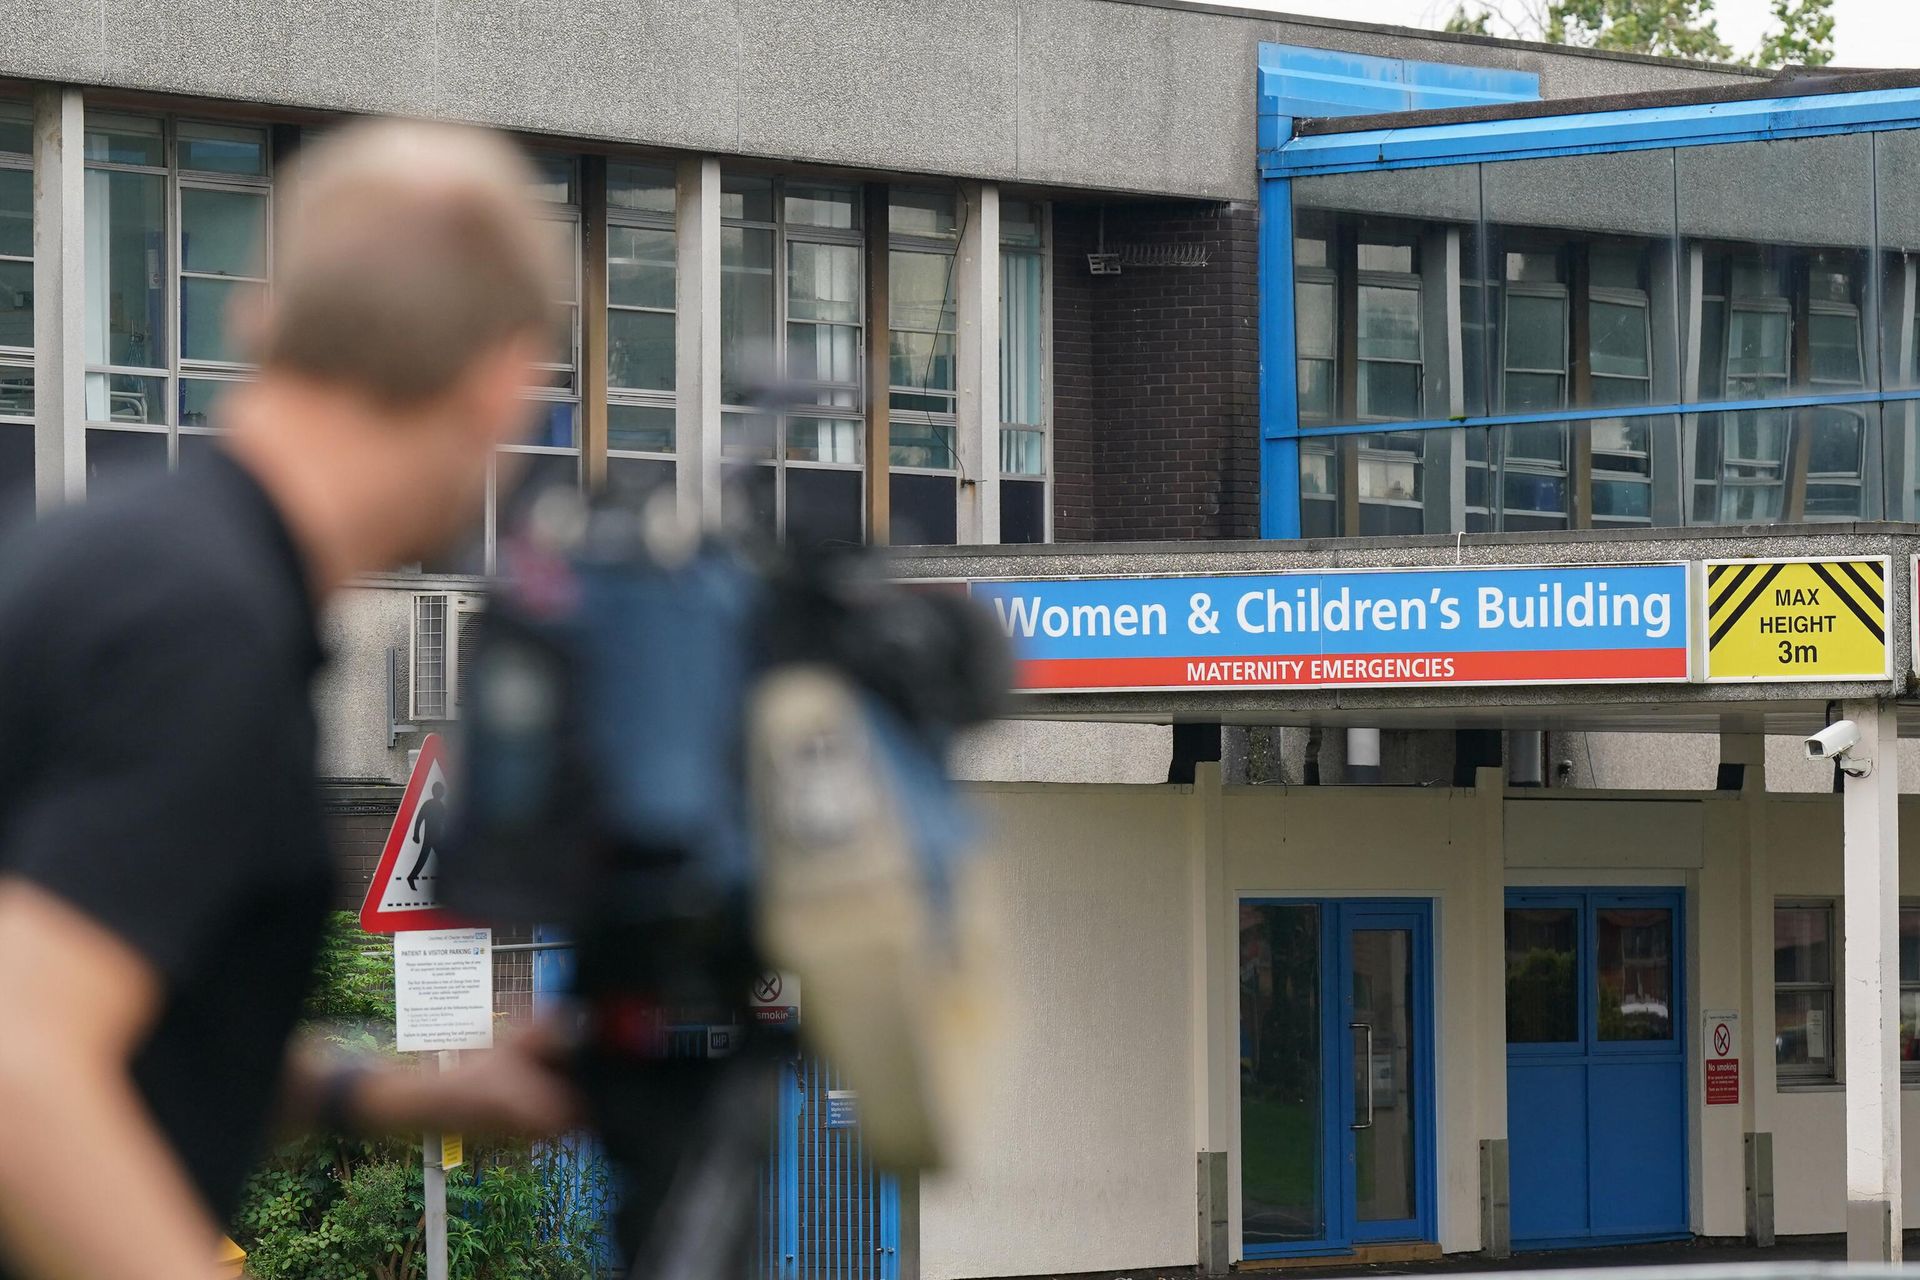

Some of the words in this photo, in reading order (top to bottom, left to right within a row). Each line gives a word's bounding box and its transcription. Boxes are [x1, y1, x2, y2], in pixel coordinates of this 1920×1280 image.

[1775, 588, 1820, 606] MAX
[994, 595, 1167, 638] Women
[1187, 592, 1221, 634] &
[1236, 586, 1460, 634] Children's
[1478, 581, 1671, 638] Building
[1760, 615, 1836, 634] HEIGHT
[1778, 640, 1818, 664] 3m
[1187, 660, 1304, 681] MATERNITY
[1311, 657, 1455, 680] EMERGENCIES
[756, 1010, 788, 1020] smokin
[1708, 1063, 1715, 1072] No
[1717, 1062, 1737, 1073] smoking
